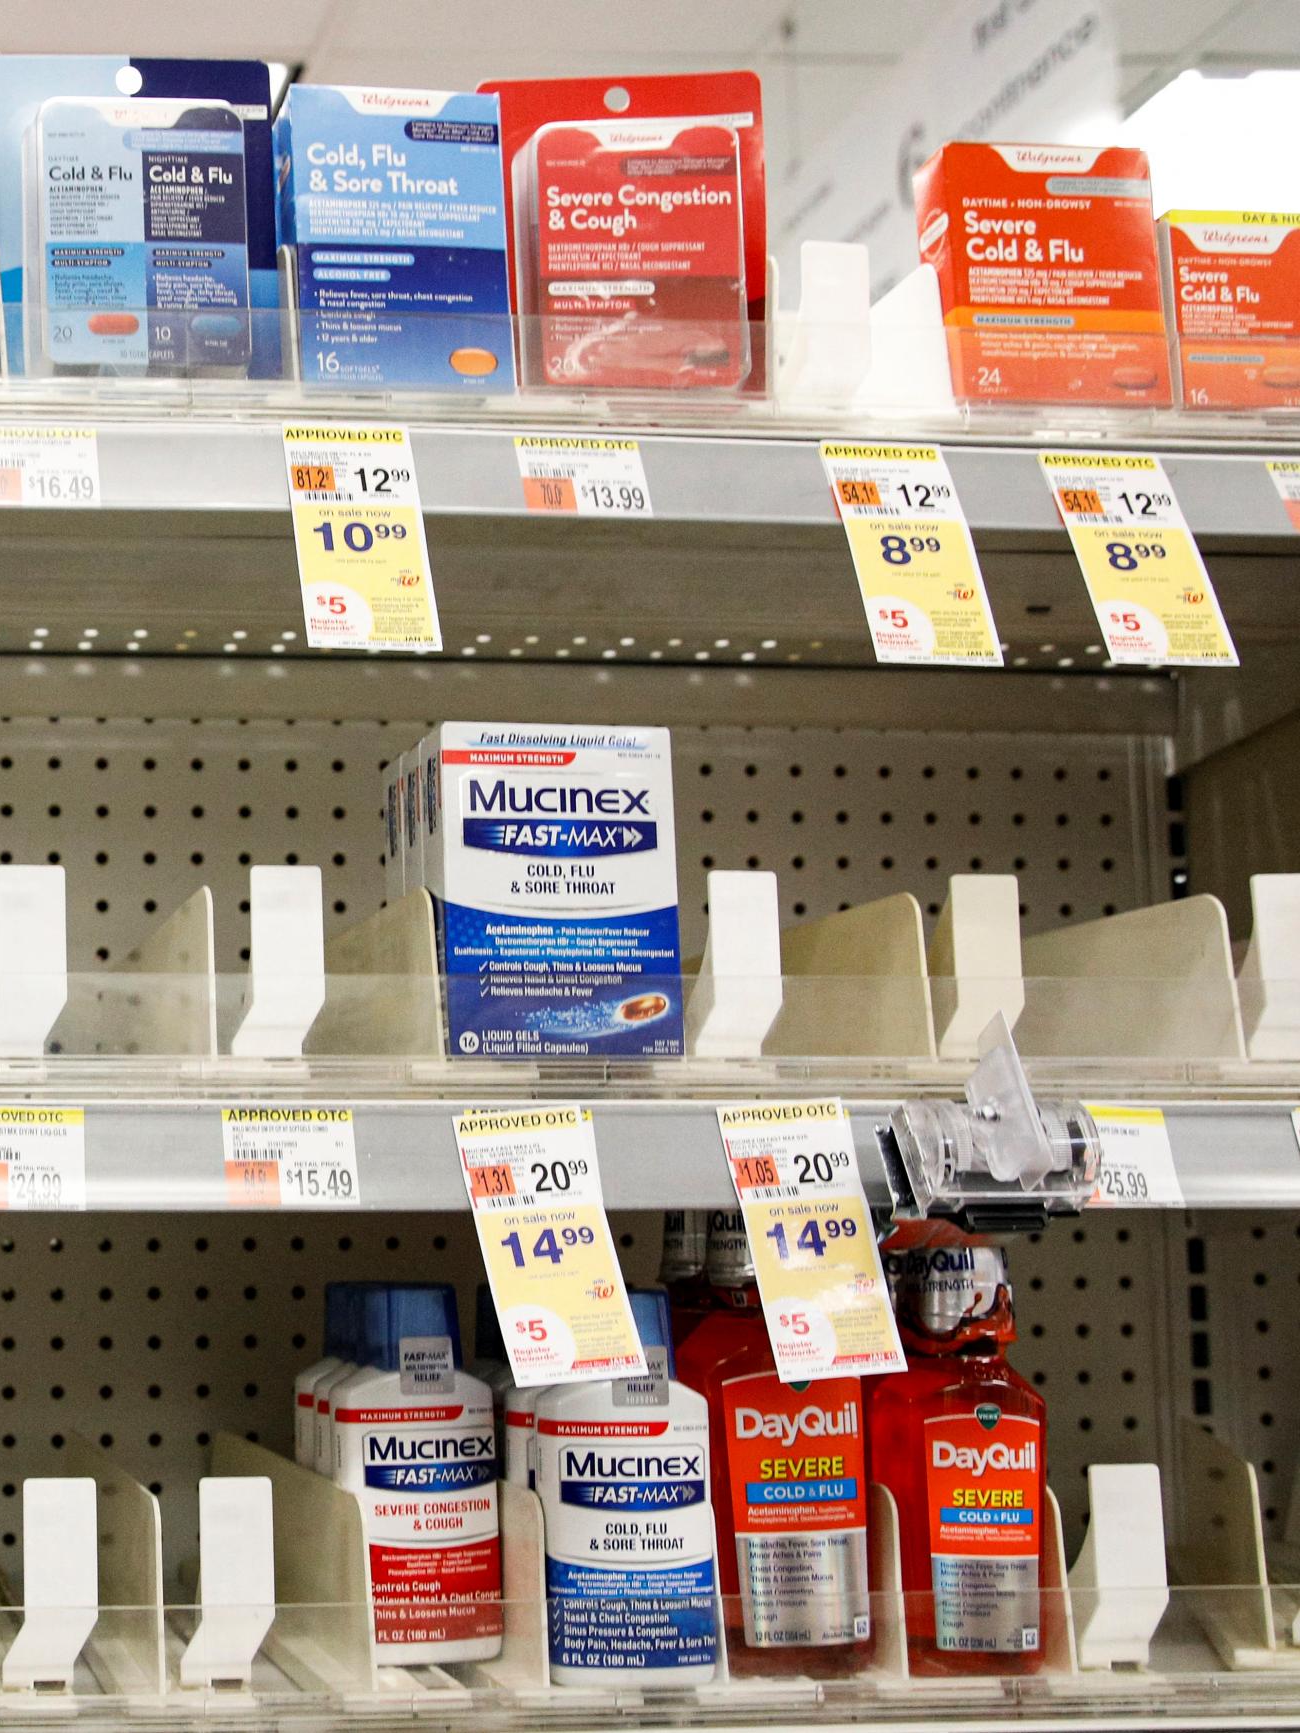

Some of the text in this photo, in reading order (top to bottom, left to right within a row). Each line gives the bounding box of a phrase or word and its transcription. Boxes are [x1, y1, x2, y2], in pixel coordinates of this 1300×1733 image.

[307, 142, 406, 169] Cold, Flu
[1016, 152, 1083, 162] Walgreens
[49, 166, 132, 181] Cold & Flu
[149, 166, 232, 184] Cold & Flu
[309, 169, 458, 195] & Sore Throat
[547, 185, 731, 213] Severe Congestion
[549, 209, 637, 236] & Cough
[963, 211, 1036, 235] Severe
[966, 238, 1084, 262] Cold & Flu
[316, 254, 410, 264] MAXIMUM STRENGTH
[317, 270, 385, 279] ALCOHOL FREE
[1179, 266, 1228, 283] Severe
[1180, 286, 1260, 303] Cold & Flu
[54, 326, 72, 339] 20
[155, 326, 171, 339] 10
[317, 352, 339, 372] 16
[978, 368, 1001, 386] 24
[1191, 390, 1208, 405] 16
[286, 429, 403, 442] APPROVED OTC
[1043, 455, 1155, 469] APPROVED OTC
[29, 475, 94, 500] $16.49
[582, 485, 645, 510] $13.99
[480, 732, 636, 748] Fast Dissolving Liquid Gels!
[470, 753, 564, 764] MAXIMUM STRENGTH
[469, 779, 650, 816] Mucinex
[527, 865, 595, 880] COLD, FLU
[511, 882, 616, 895] & SORE THROAT
[228, 1110, 348, 1122] APPROVED OTC
[459, 1112, 576, 1134] APPROVED OTC
[10, 1174, 62, 1200] $24.99
[286, 1169, 353, 1198] $15.49
[360, 1411, 446, 1421] MAXIMUM STRENGTH
[735, 1402, 858, 1446] DayQuil
[369, 1436, 492, 1461] Mucinex
[566, 1451, 699, 1477] Mucinex
[932, 1441, 1036, 1477] DayQuil
[759, 1457, 844, 1480] SEVERE
[952, 1489, 1024, 1508] SEVERE
[374, 1499, 490, 1516] SEVERE CONGESTION
[413, 1517, 463, 1530] & COUGH
[605, 1522, 667, 1538] COLD, FLU
[590, 1537, 684, 1551] & SORE THROAT
